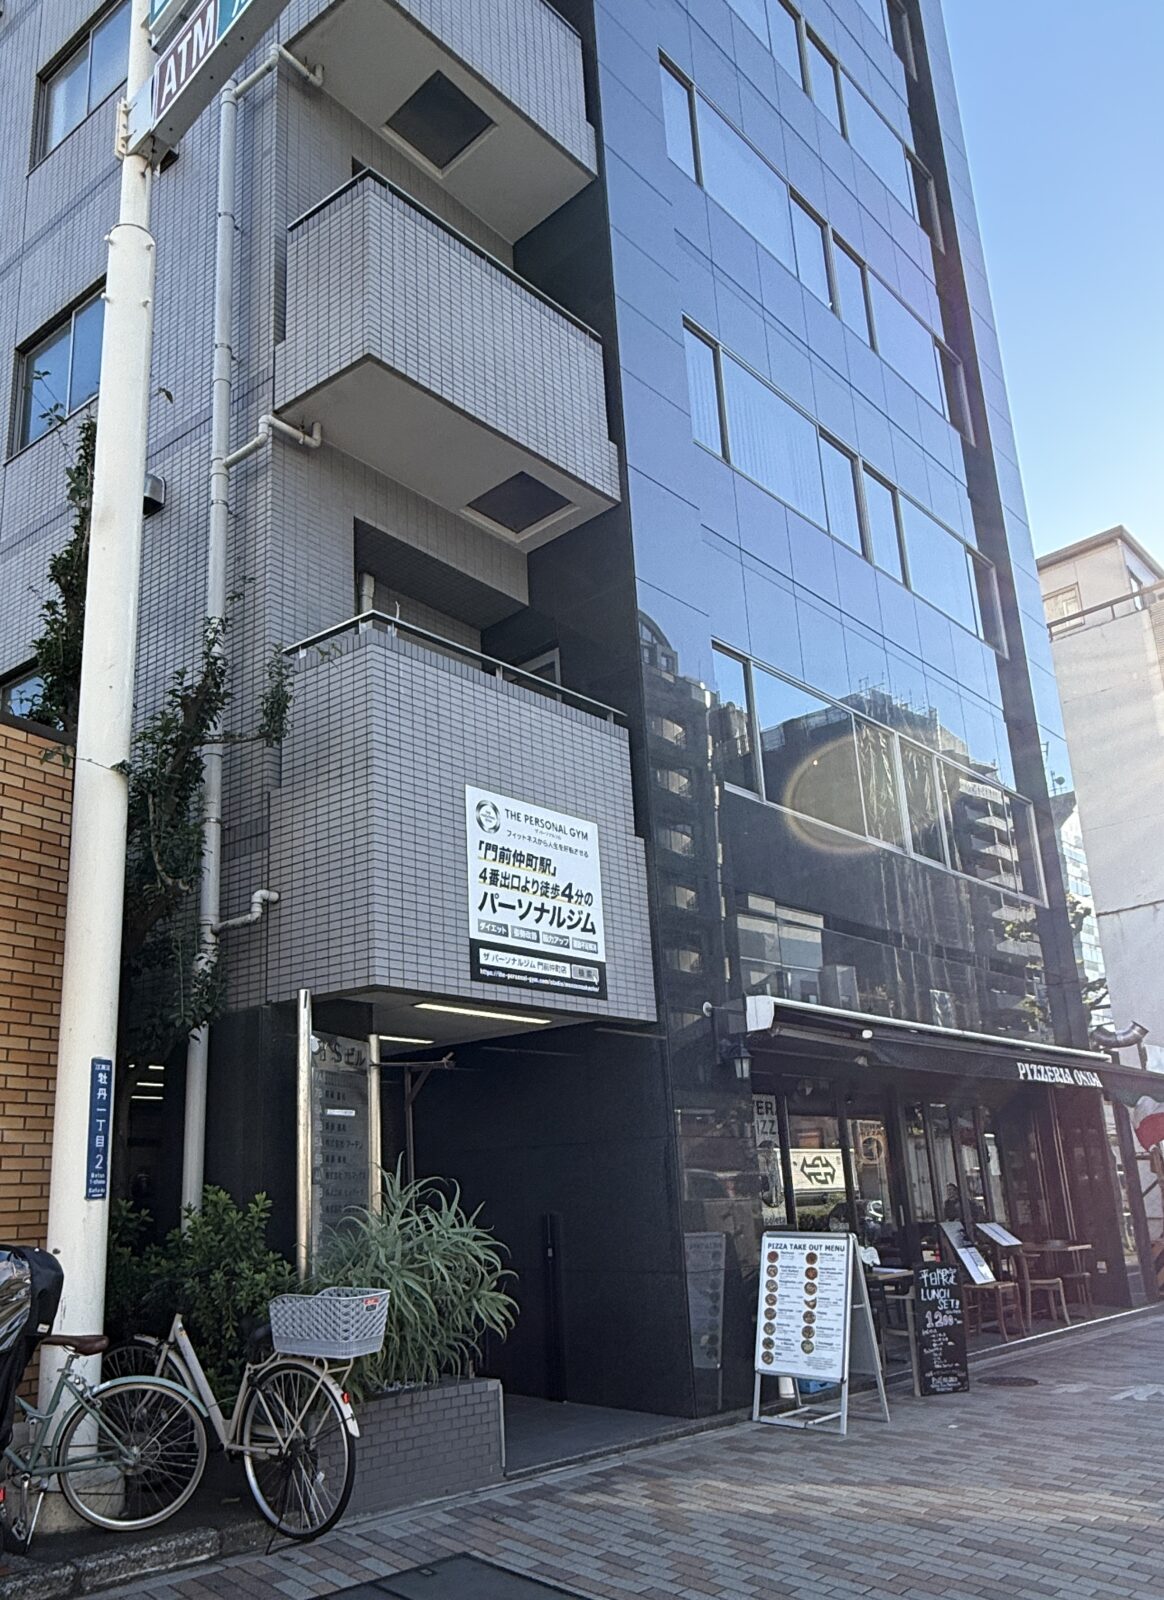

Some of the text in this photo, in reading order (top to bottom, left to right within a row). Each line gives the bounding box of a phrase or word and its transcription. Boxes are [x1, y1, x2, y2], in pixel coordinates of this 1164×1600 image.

[160, 1, 215, 110] ATM
[505, 808, 522, 822] THE
[524, 814, 568, 834] PERSONAL
[569, 827, 588, 840] GYM
[478, 840, 557, 877] 「門前仲町駅」
[478, 867, 594, 907] 4番出口より徒歩4分の
[478, 890, 596, 935] パーソナルジム
[479, 922, 507, 935] ダイエット
[492, 954, 536, 969] パーソナルジム
[1016, 1062, 1104, 1088] PIZZERIA ONDA
[808, 1244, 823, 1252] OUT
[920, 1288, 950, 1302] LUNCH
